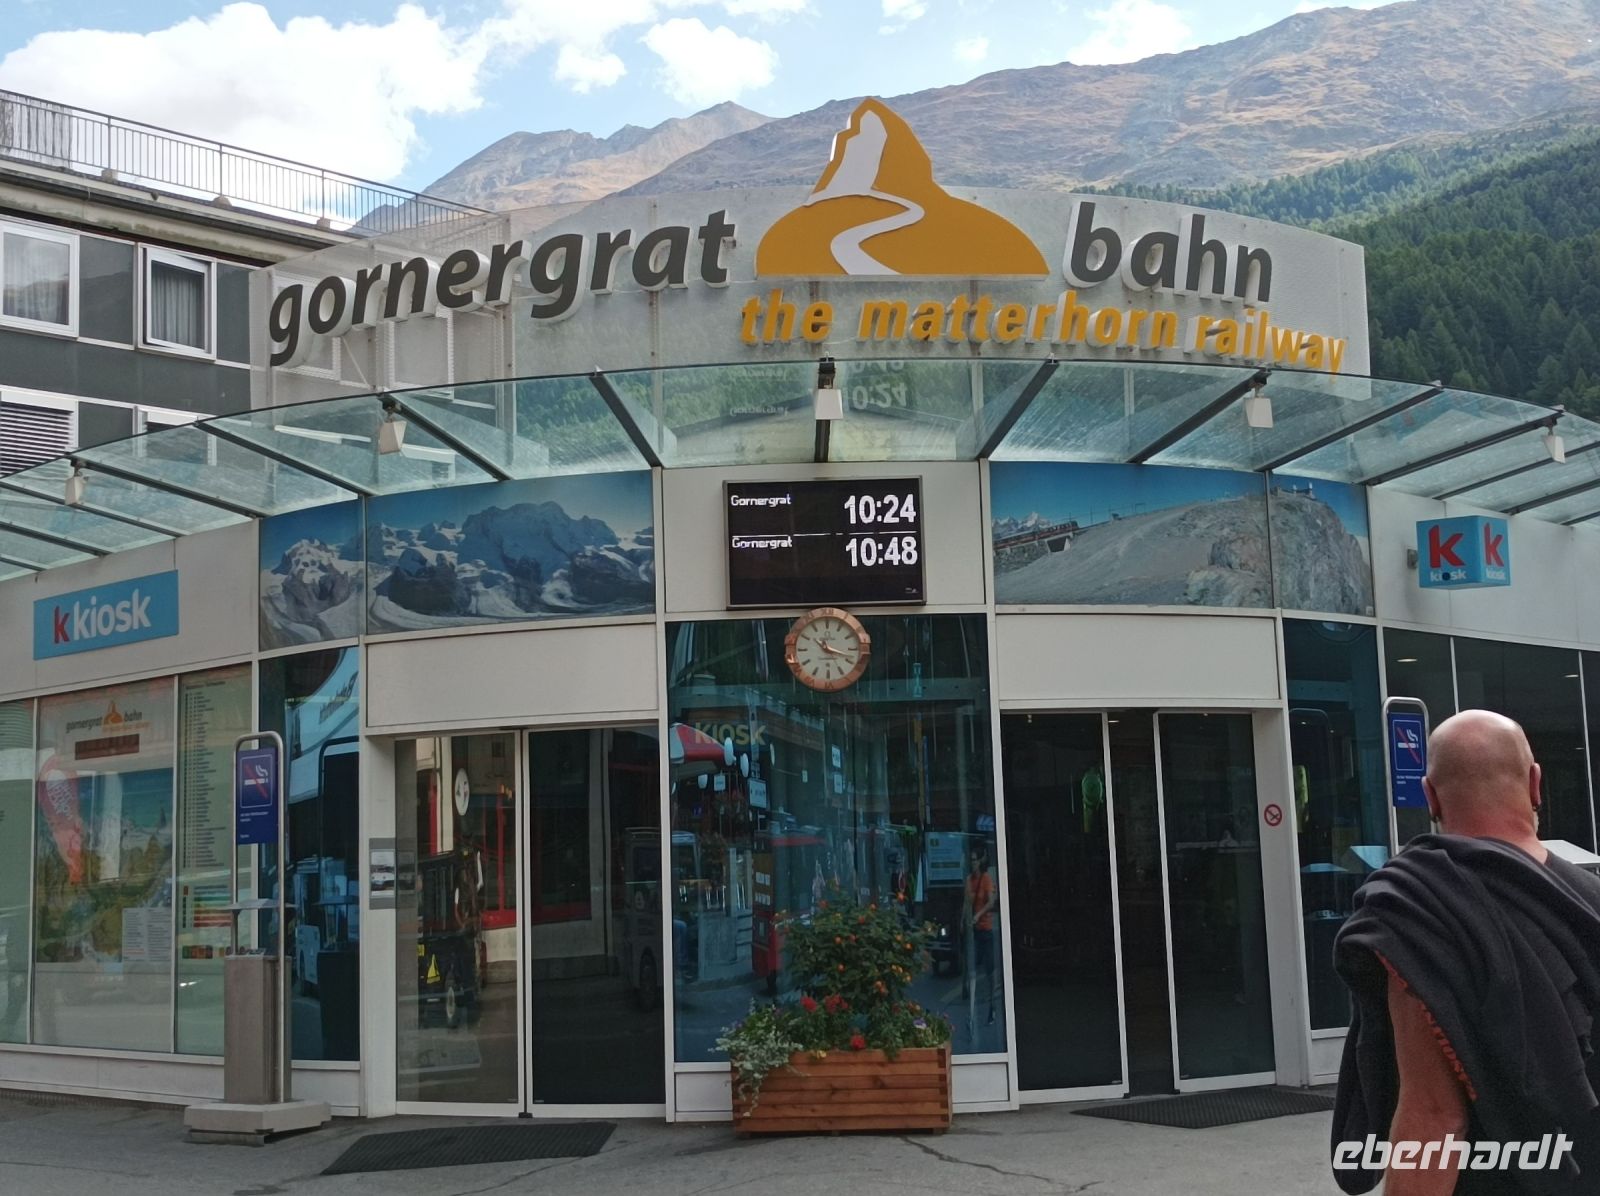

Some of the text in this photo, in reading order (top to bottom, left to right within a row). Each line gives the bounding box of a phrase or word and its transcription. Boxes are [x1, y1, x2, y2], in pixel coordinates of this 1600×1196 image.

[269, 201, 1273, 366] gornergrat bahn
[740, 289, 1346, 378] the matterhorn railway
[730, 493, 917, 525] Gornergrat 10:24
[731, 535, 918, 567] Gornergrat 10:48
[1430, 568, 1467, 582] kisk
[695, 721, 767, 746] KIOSK
